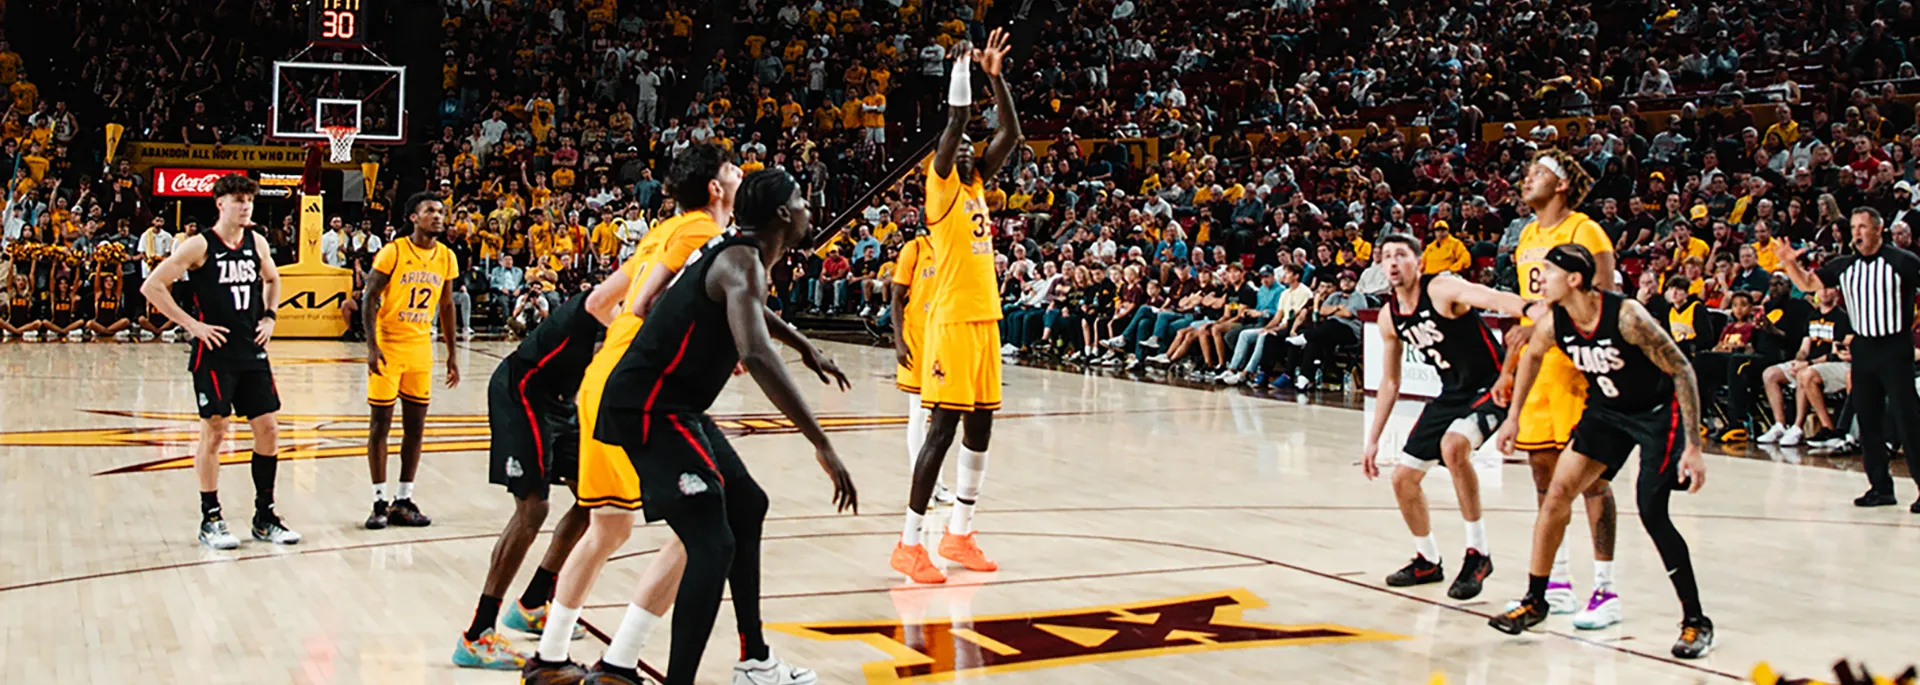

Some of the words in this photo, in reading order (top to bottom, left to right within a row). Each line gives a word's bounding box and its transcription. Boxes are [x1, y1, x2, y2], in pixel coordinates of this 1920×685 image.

[322, 10, 354, 39] 30
[141, 147, 189, 158] ABANDON
[192, 149, 210, 159] ALL
[213, 149, 238, 160] HOPE
[242, 150, 255, 160] YE
[258, 150, 284, 161] WHO
[971, 212, 990, 238] 3
[216, 259, 257, 283] ZAGS
[230, 285, 251, 311] 17
[408, 286, 432, 309] 12
[1402, 319, 1444, 349] ZAGS
[1427, 348, 1451, 370] 2
[1566, 345, 1625, 374] ZAGS
[1596, 375, 1620, 398] 8
